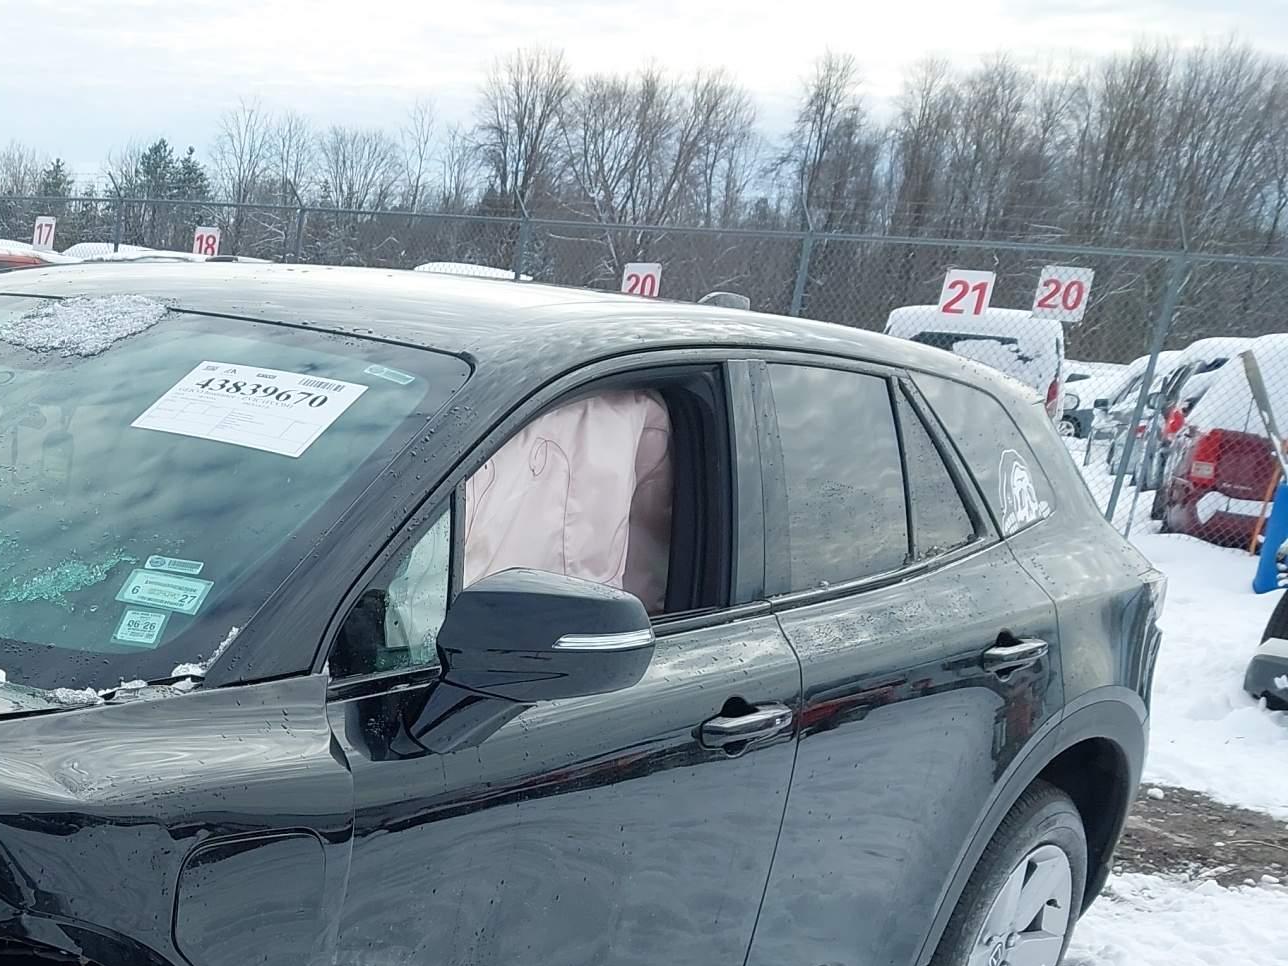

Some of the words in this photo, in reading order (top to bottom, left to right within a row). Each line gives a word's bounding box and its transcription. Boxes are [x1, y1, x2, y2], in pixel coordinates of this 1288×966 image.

[36, 223, 54, 245] 17
[196, 234, 217, 256] 18
[626, 273, 656, 297] 20
[941, 279, 989, 315] 21
[1036, 279, 1085, 311] 20
[195, 377, 329, 409] 43839670
[131, 585, 141, 595] 6
